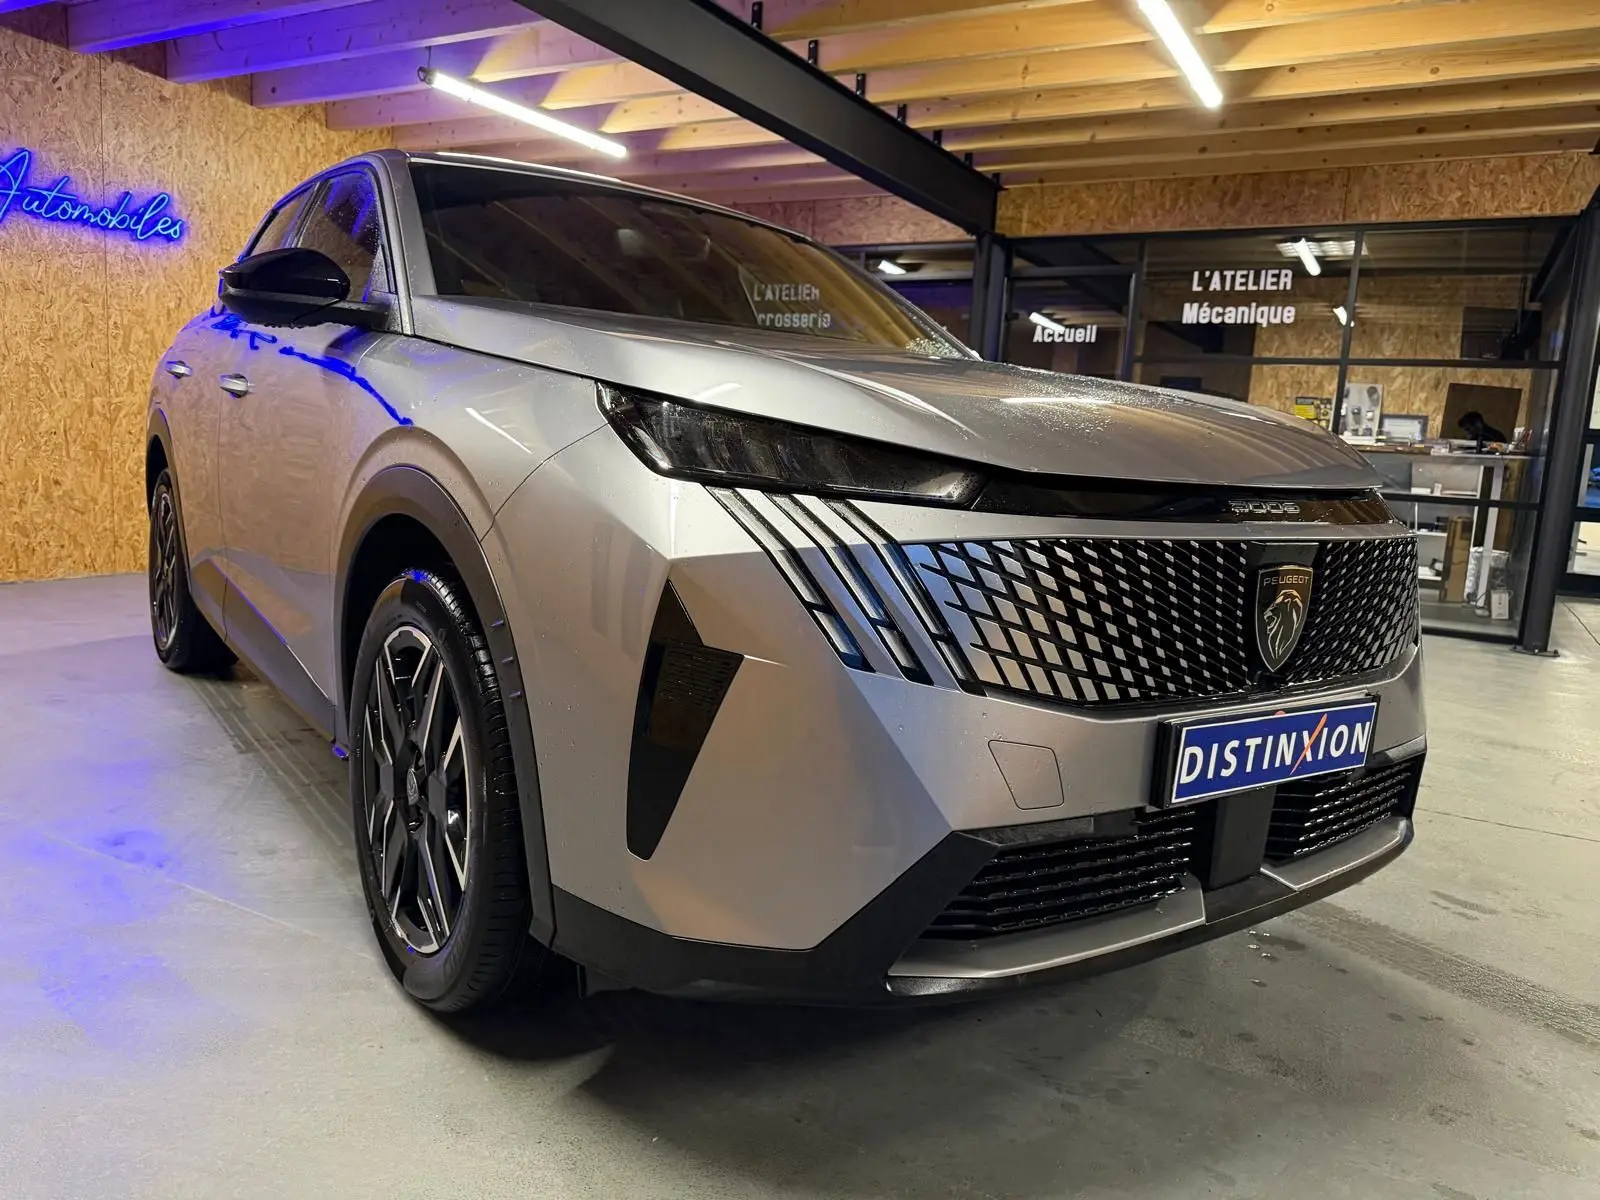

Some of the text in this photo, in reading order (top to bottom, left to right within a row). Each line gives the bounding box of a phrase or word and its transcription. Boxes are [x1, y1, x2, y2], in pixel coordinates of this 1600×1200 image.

[0, 149, 185, 240] Automobiles
[1192, 269, 1293, 292] L'ATELIER
[1182, 302, 1296, 327] Mécanique
[1033, 324, 1098, 343] Accueil
[1263, 575, 1310, 587] PEUGEOT
[1179, 713, 1371, 785] DISTINXION
